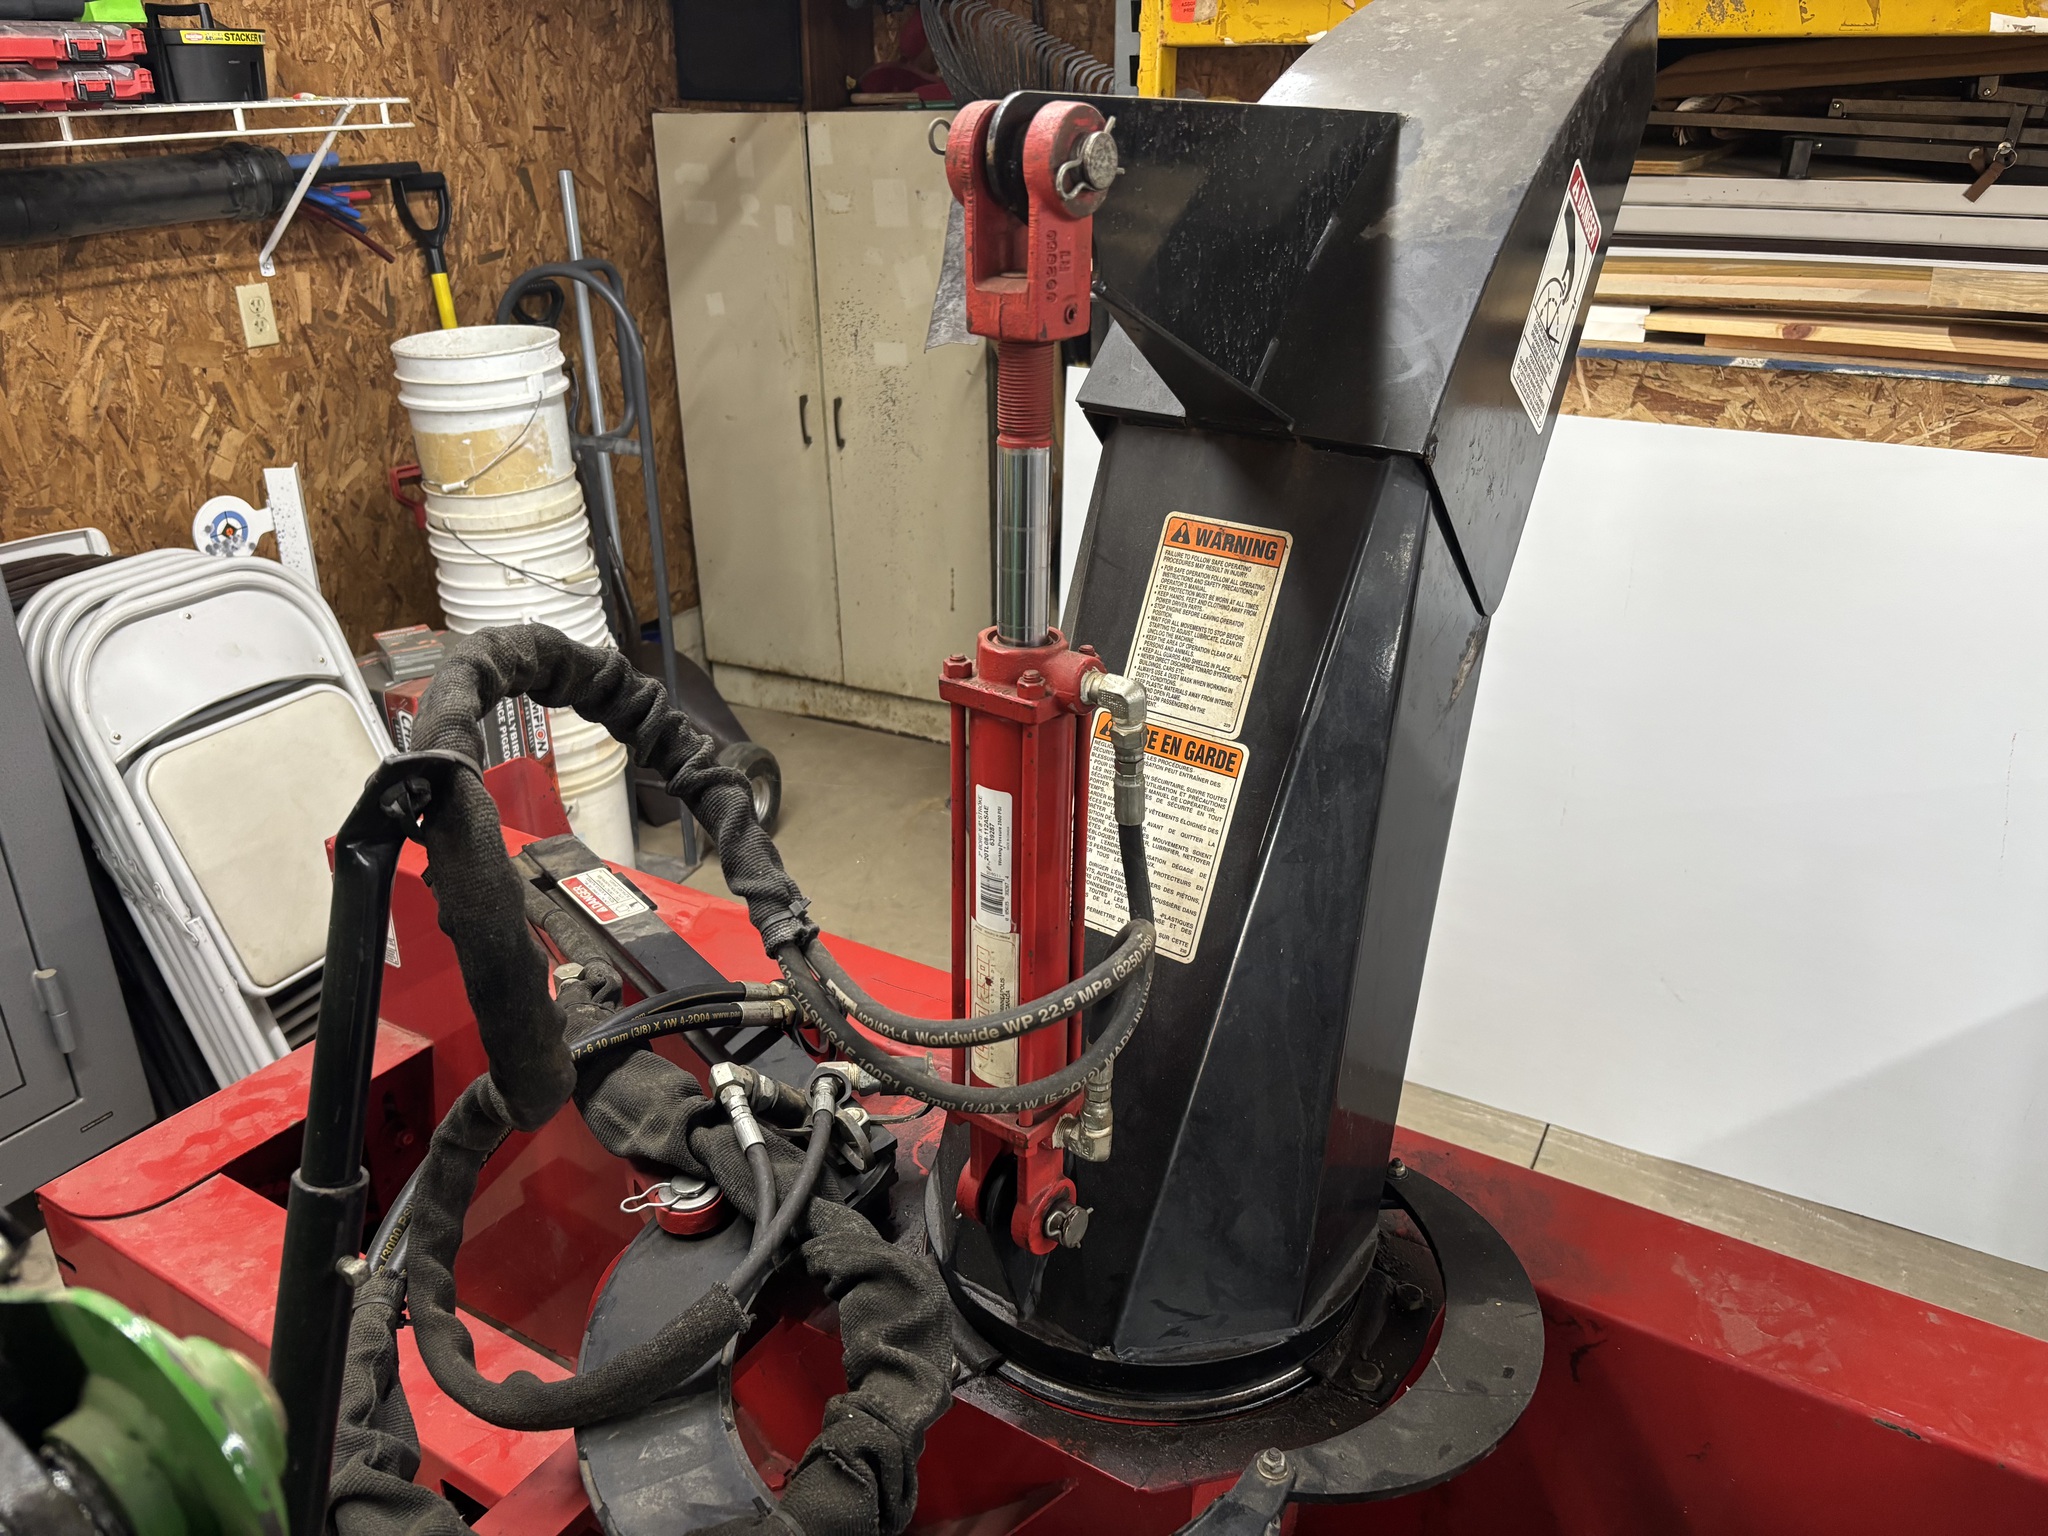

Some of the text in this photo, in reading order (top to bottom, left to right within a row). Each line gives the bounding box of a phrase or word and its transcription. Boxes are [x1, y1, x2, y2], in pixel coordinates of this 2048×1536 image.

[224, 33, 258, 42] STACKER
[1576, 186, 1597, 248] DANGER
[1195, 528, 1278, 561] WARNING
[1163, 556, 1194, 567] PROCEDURES
[1205, 564, 1223, 573] RESULT
[1164, 549, 1183, 558] FAILURE
[1190, 555, 1211, 564] FOLLOW
[1224, 561, 1251, 572] OPERATING
[1162, 571, 1193, 582] INSTRUCTIONS
[1203, 580, 1220, 588] SAFETY
[1185, 569, 1210, 579] OPERATION
[1210, 574, 1229, 583] FOLLOW
[1238, 580, 1265, 591] OPERATING
[1187, 583, 1207, 592] MANUAL.
[1167, 586, 1195, 596] PROTECTION
[1155, 596, 1171, 604] POWER
[1171, 600, 1187, 608] DRIVEN
[1207, 601, 1229, 611] CLOTHING
[1243, 609, 1257, 617] FROM
[1180, 622, 1207, 632] MOVEMENTS
[1213, 629, 1225, 637] STOP
[1226, 632, 1244, 641] BEFORE
[1156, 636, 1166, 644] THE
[1165, 638, 1178, 646] AREA
[1185, 643, 1210, 654] OPERATION
[1210, 649, 1225, 658] CLEAR
[1232, 654, 1242, 662] ALL
[1140, 652, 1154, 660] NEVER
[1154, 656, 1169, 664] DIRECT
[1170, 660, 1194, 670] DISCHARGE
[1194, 666, 1212, 675] TOWARD
[505, 697, 520, 758] HEELYBIRD
[532, 702, 547, 751] MPION
[1146, 754, 1193, 772] LES PROCÉDURES
[1160, 733, 1182, 757] EN
[1184, 740, 1238, 773] GARDE
[1163, 767, 1177, 775] PEUT
[1209, 779, 1221, 788] DES
[1148, 788, 1169, 800] MANUEL
[1185, 785, 1205, 796] SUIVRE
[1206, 791, 1228, 803] TOUTES
[1187, 793, 1226, 809] PRÉCAUTIONS
[1196, 809, 1204, 817] EN
[1207, 812, 1222, 822] TOUT
[1146, 821, 1163, 831] AVANT
[1168, 827, 1175, 835] DE
[1180, 831, 1203, 843] QUITTER
[1207, 826, 1219, 835] DES
[1152, 836, 1212, 859] MOUVEMENTS SOIENT
[1182, 852, 1210, 866] NETTOYER
[1153, 869, 1191, 887] PROTECTEURS
[571, 884, 604, 909] DANGER
[1157, 932, 1188, 947] SUR CETTE
[858, 1012, 908, 1040] 422/421-4
[915, 1026, 999, 1045] Worldwide
[1003, 1015, 1033, 1034] WP
[1038, 996, 1075, 1023] 22,5
[1077, 976, 1112, 1004] MPa
[1112, 950, 1142, 981] (3250
[596, 1038, 608, 1049] 10
[610, 1032, 628, 1044] mm
[630, 1024, 651, 1038] (3/8)
[653, 1021, 661, 1031] X
[663, 1018, 677, 1028] 1W
[858, 1057, 900, 1089] 100R1
[904, 1086, 955, 1110] 6.3mm
[961, 1101, 995, 1114] (1/4)
[1000, 1104, 1010, 1113] X
[1016, 1098, 1039, 1111] 1W
[1104, 1025, 1134, 1066] MADE
[1134, 1008, 1143, 1023] IN
[380, 1228, 402, 1261] (3000
